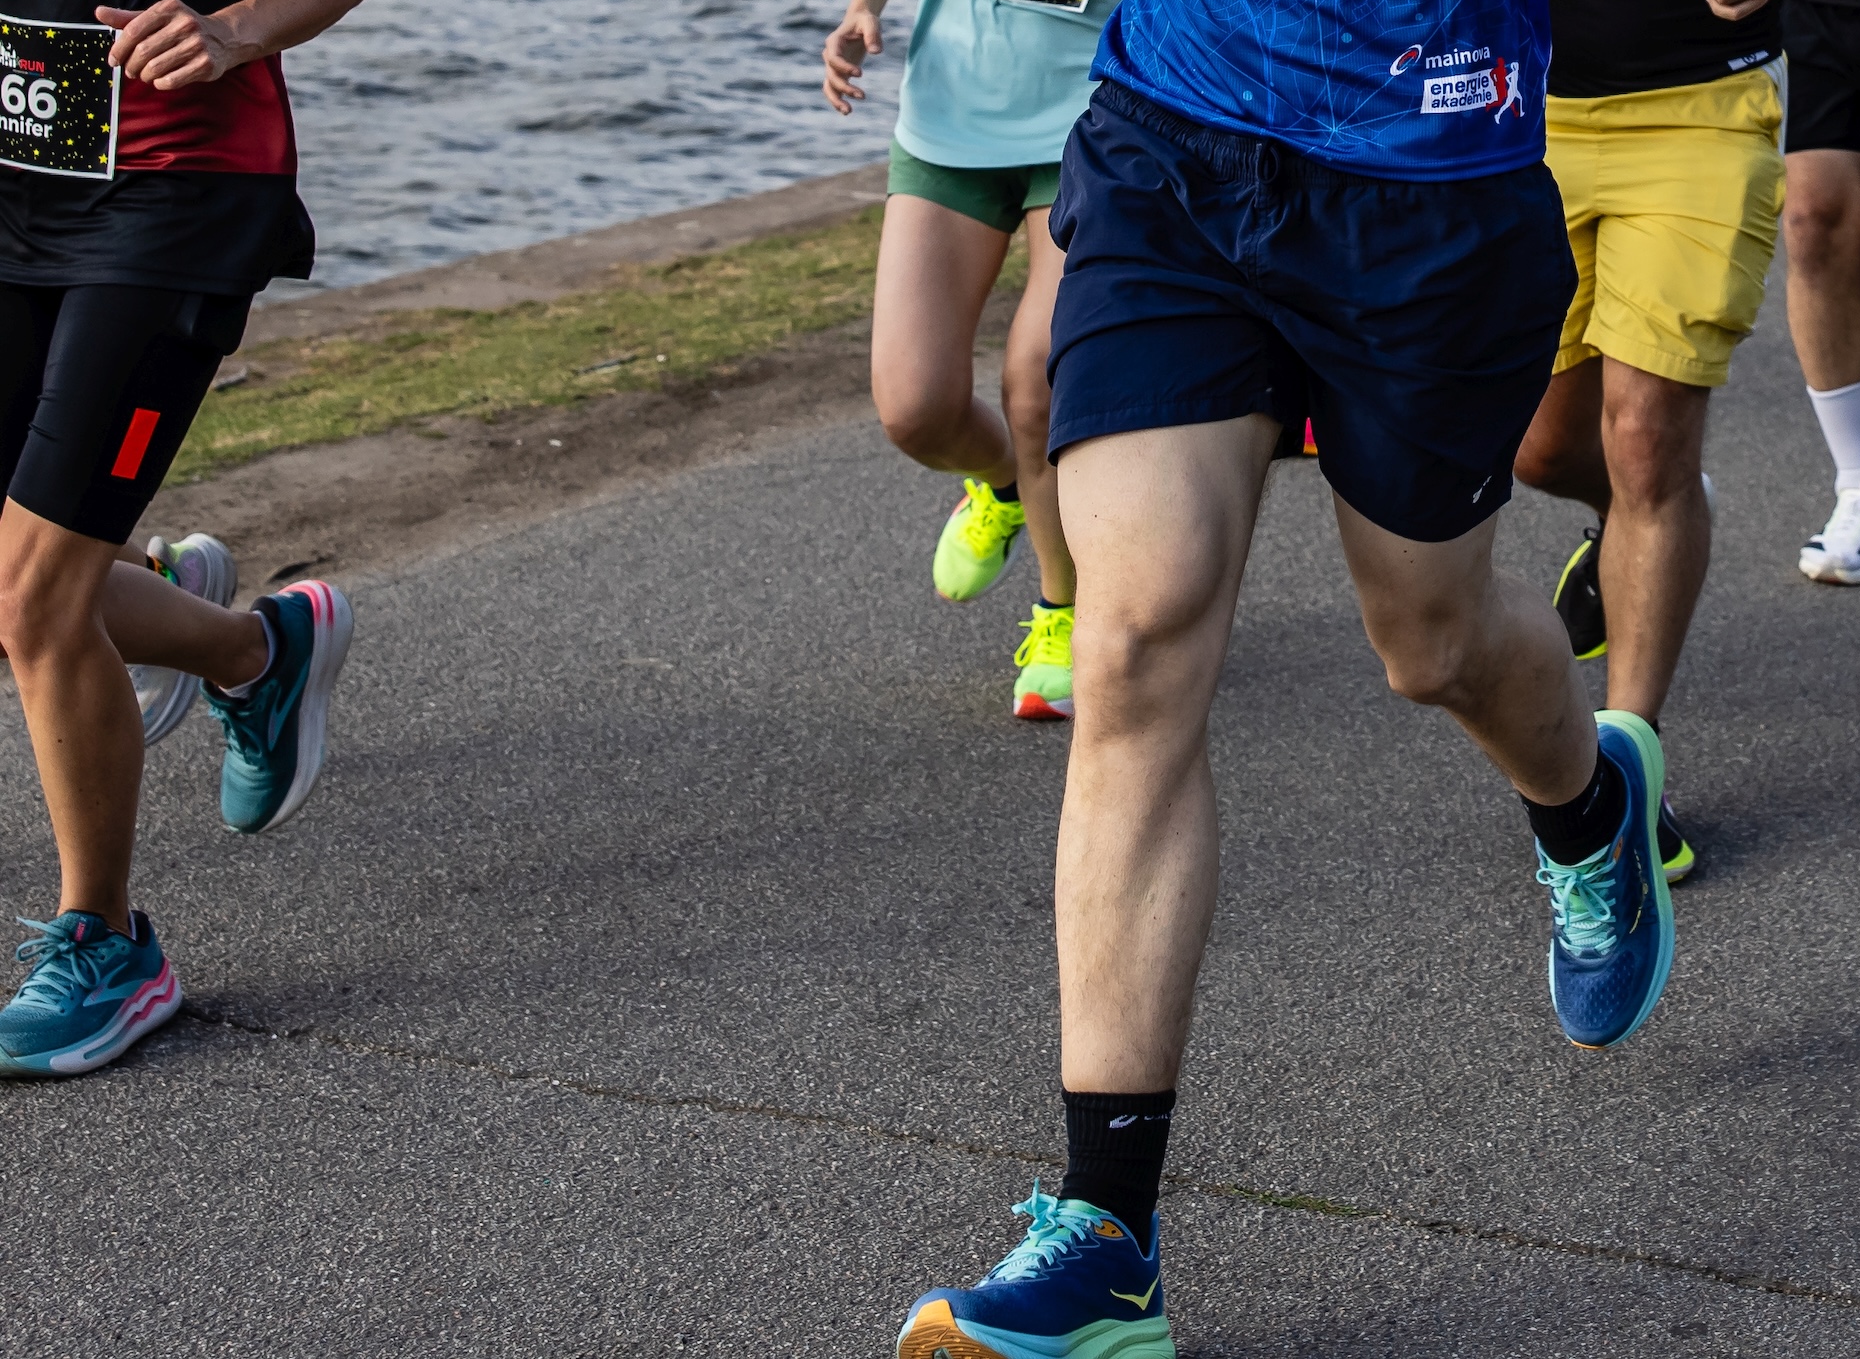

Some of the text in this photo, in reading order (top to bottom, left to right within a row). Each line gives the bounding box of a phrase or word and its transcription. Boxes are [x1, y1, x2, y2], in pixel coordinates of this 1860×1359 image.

[18, 58, 45, 72] RUN
[1425, 46, 1491, 70] mainova
[1430, 75, 1490, 96] energie
[1431, 90, 1492, 109] akademie
